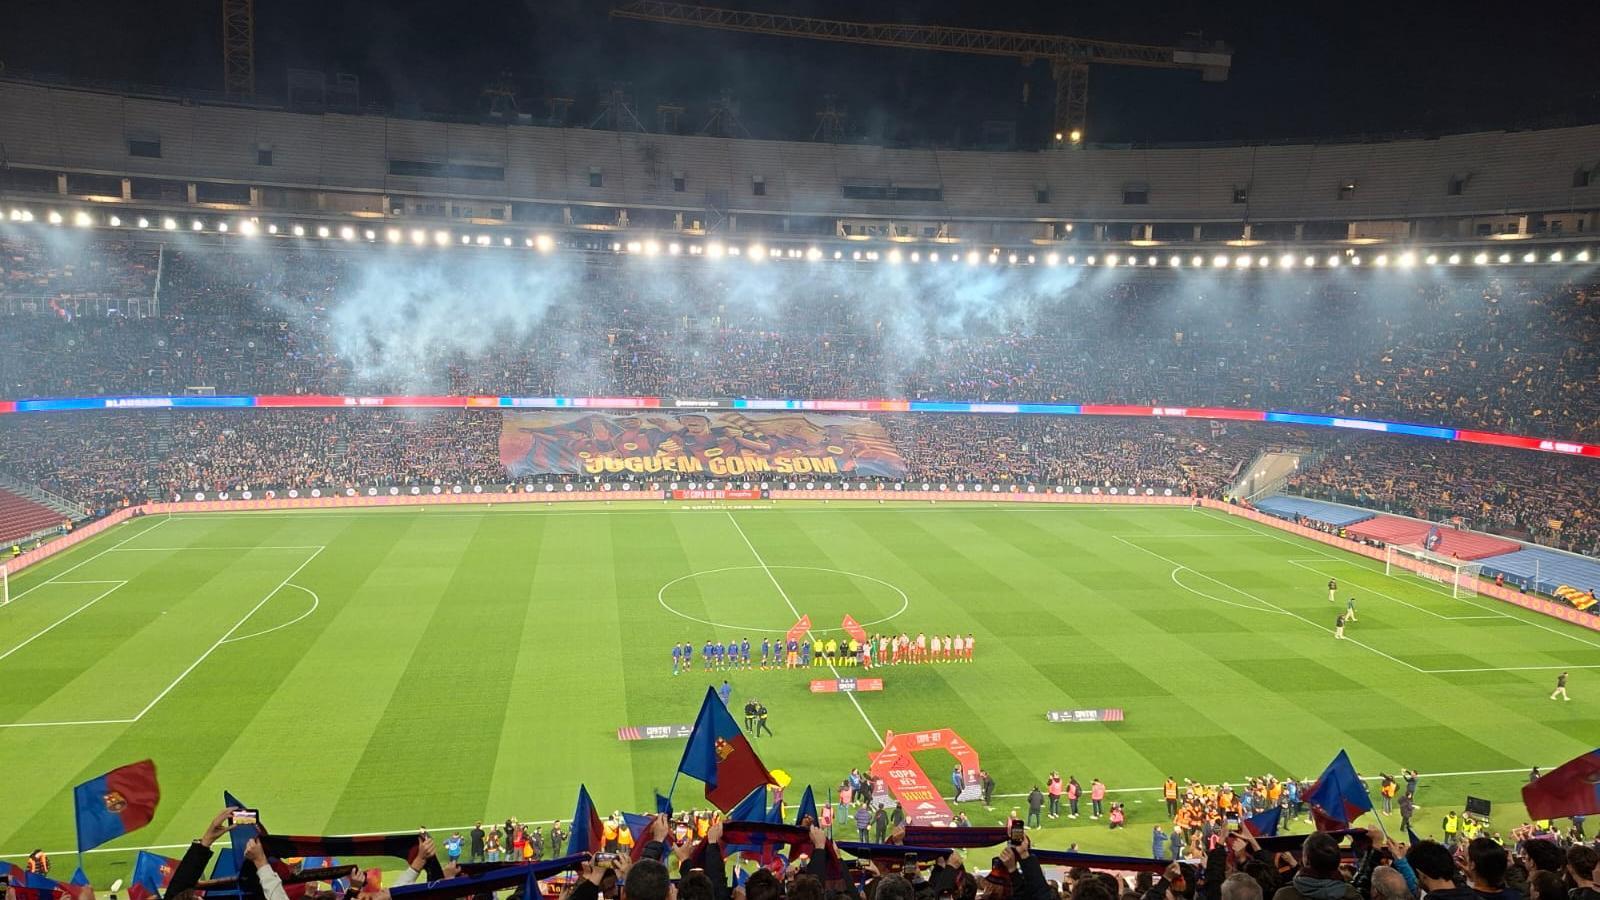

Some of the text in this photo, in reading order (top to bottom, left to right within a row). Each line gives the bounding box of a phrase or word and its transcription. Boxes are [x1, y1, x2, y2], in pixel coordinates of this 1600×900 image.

[585, 456, 838, 475] JUGUEM COM SOM
[888, 769, 917, 778] COPA
